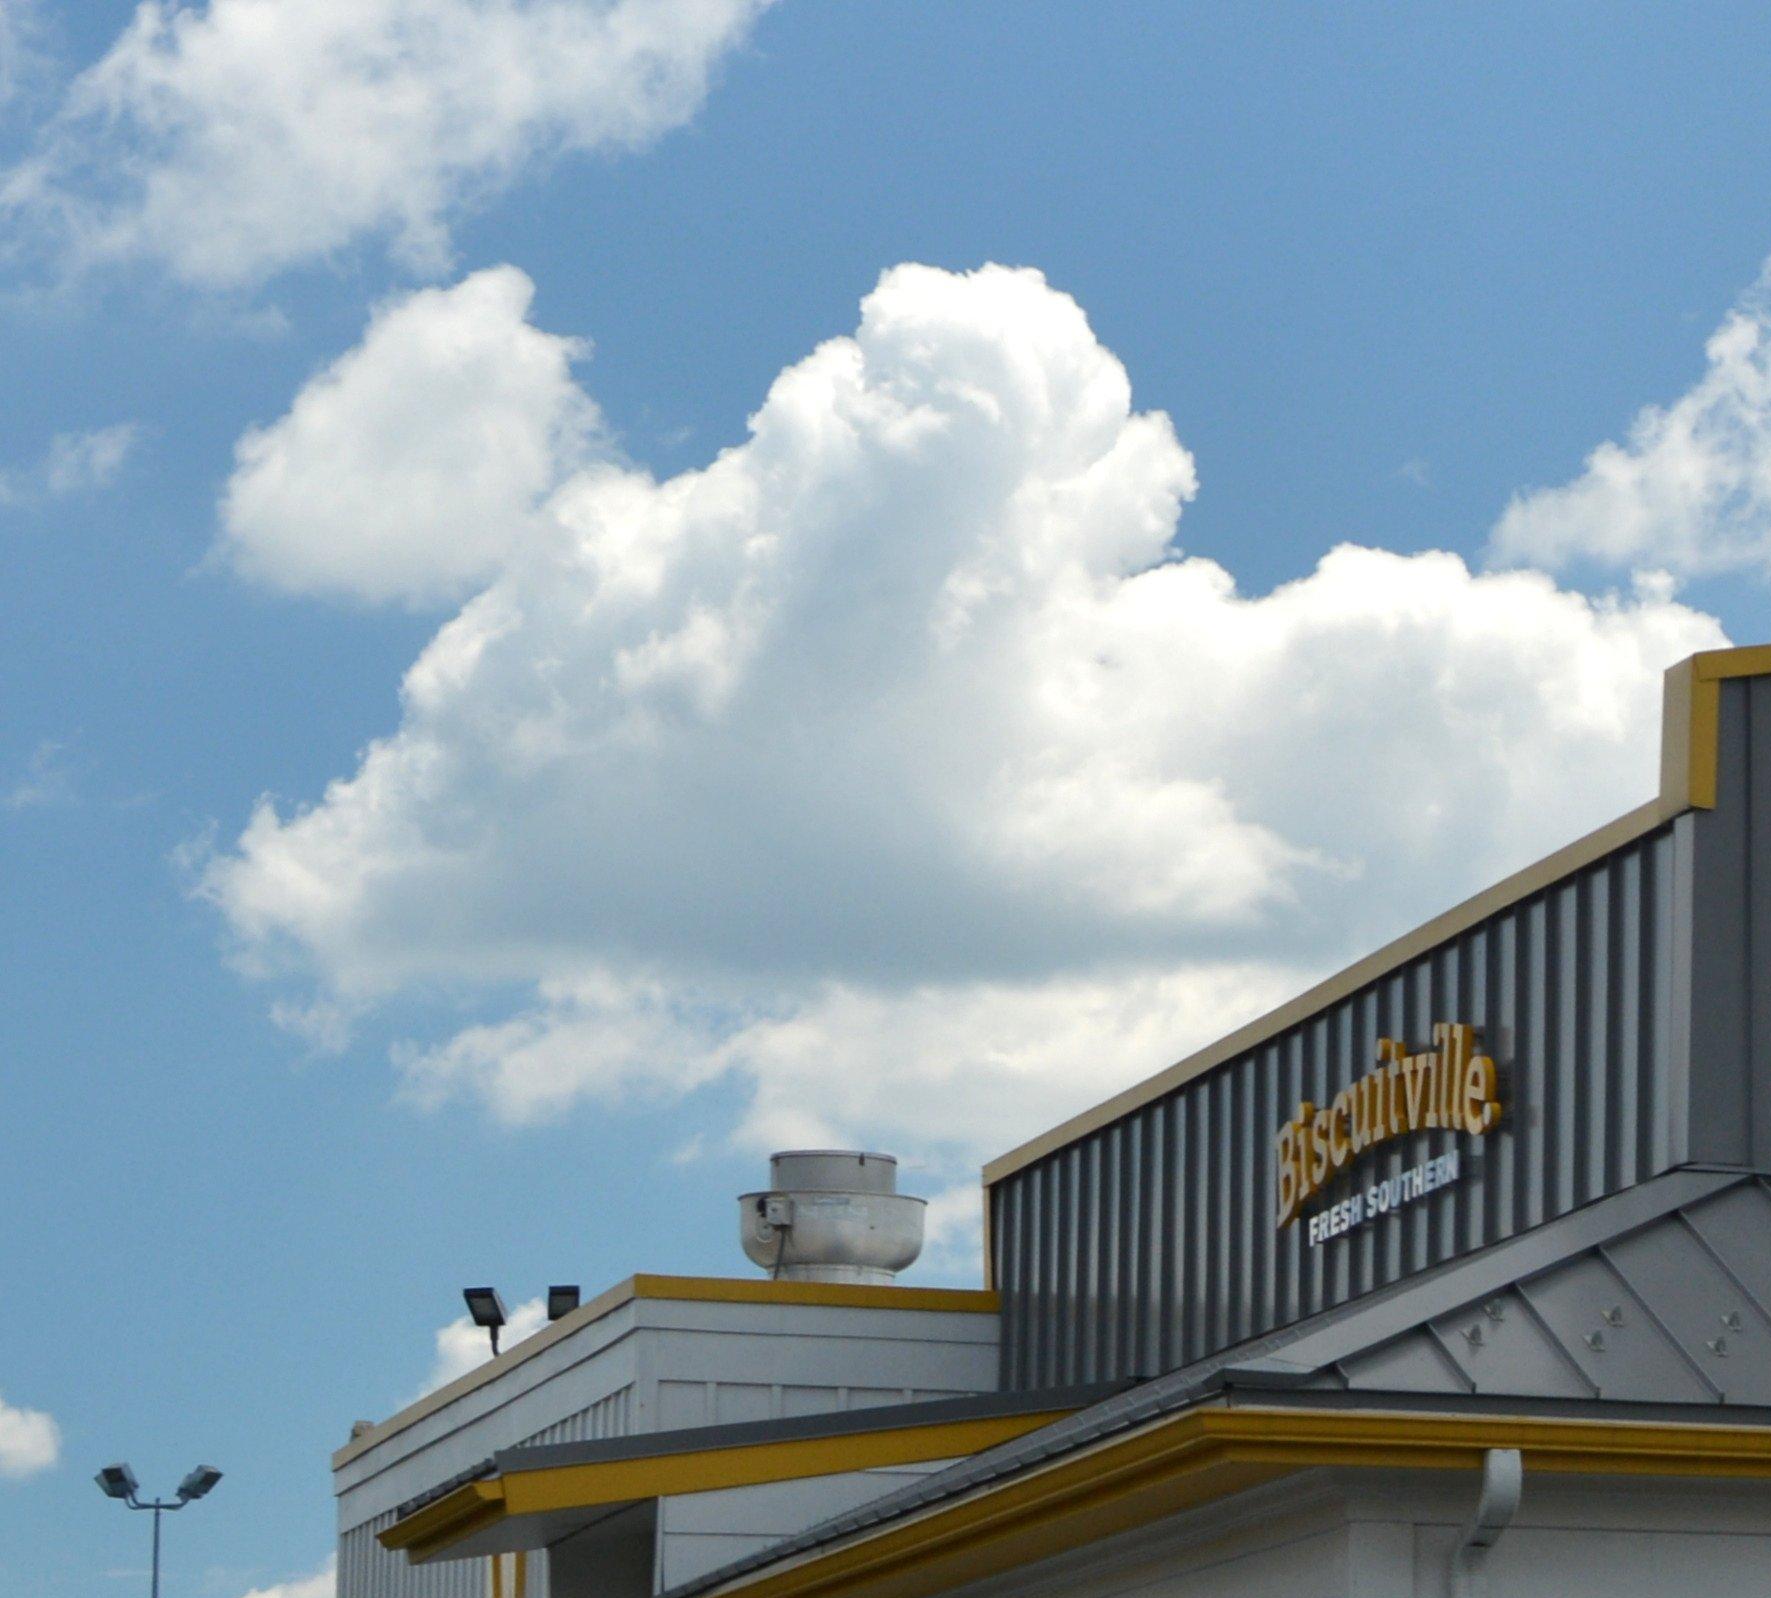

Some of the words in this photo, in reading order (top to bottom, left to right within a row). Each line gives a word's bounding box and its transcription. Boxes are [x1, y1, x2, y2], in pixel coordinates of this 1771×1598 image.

[1275, 1021, 1499, 1230] Biscuitville
[1308, 1192, 1363, 1247] FRESH
[1366, 1149, 1460, 1218] SOUTHERN
